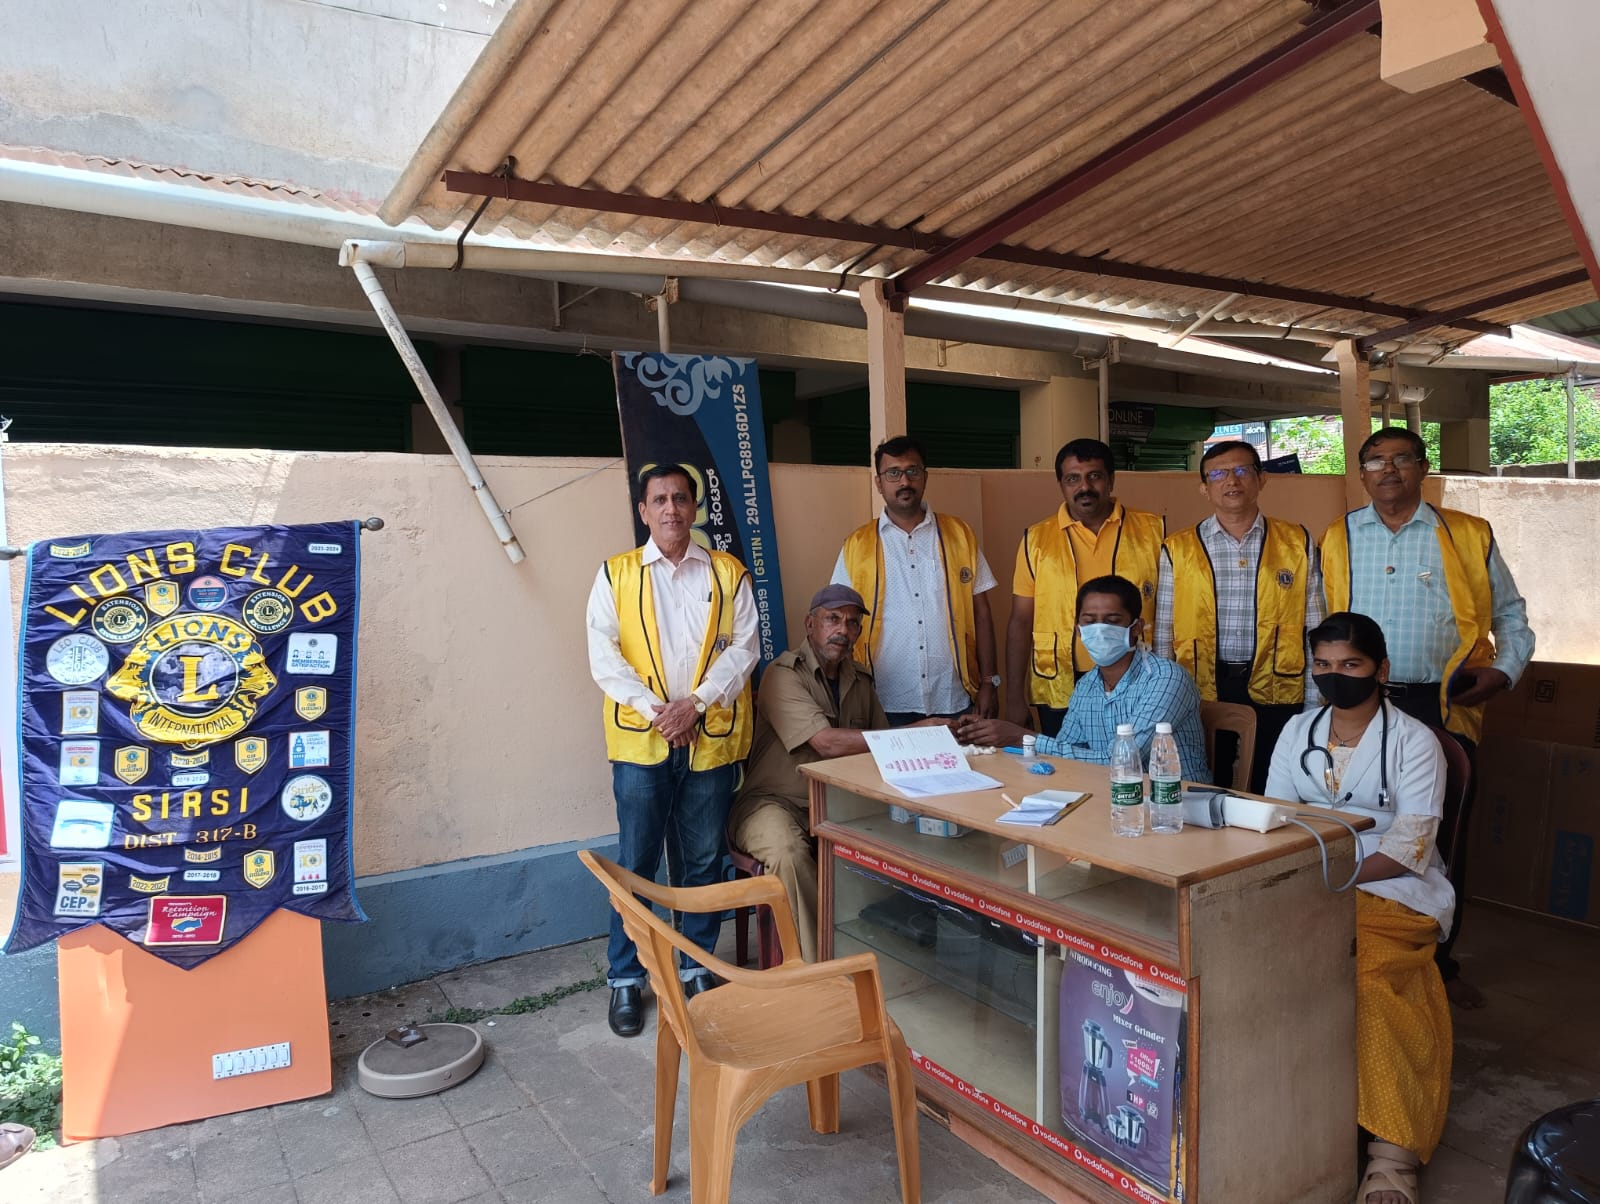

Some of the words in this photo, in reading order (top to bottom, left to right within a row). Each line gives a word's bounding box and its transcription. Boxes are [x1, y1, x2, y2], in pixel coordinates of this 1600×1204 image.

[751, 537, 766, 577] GSTIN
[44, 541, 196, 626] LIONS
[220, 543, 338, 623] CLUB
[250, 591, 287, 603] EXTENSION
[101, 600, 140, 612] EXTENSION
[153, 618, 247, 648] LIONS
[249, 617, 288, 631] EXCELLENCE
[757, 588, 775, 661] 9379051919
[53, 638, 72, 654] LEO
[78, 636, 103, 654] CLUB
[177, 656, 220, 703] L
[148, 711, 237, 735] INTERNATIONAL
[132, 788, 248, 821] SIRSI
[124, 831, 178, 850] DIST
[196, 824, 257, 844] 317-B
[132, 879, 166, 890] 2022-2023
[60, 895, 87, 909] CEP
[161, 905, 209, 913] Retention
[167, 911, 217, 919] Campaign
[888, 865, 909, 878] vodafone
[918, 877, 941, 891] vodafone
[950, 889, 975, 904] vodafone
[985, 902, 1011, 918] vodafone
[1023, 917, 1052, 934] vodafone
[1064, 932, 1096, 951] vodafone
[1109, 949, 1144, 970] vodafone
[1091, 980, 1134, 1015] enjoy
[1113, 1014, 1133, 1030] Mixer
[1135, 1024, 1166, 1044] Grinder
[1001, 1107, 1028, 1128] vodafone
[1040, 1130, 1069, 1152] vodafone
[1082, 1156, 1115, 1180] vodafone
